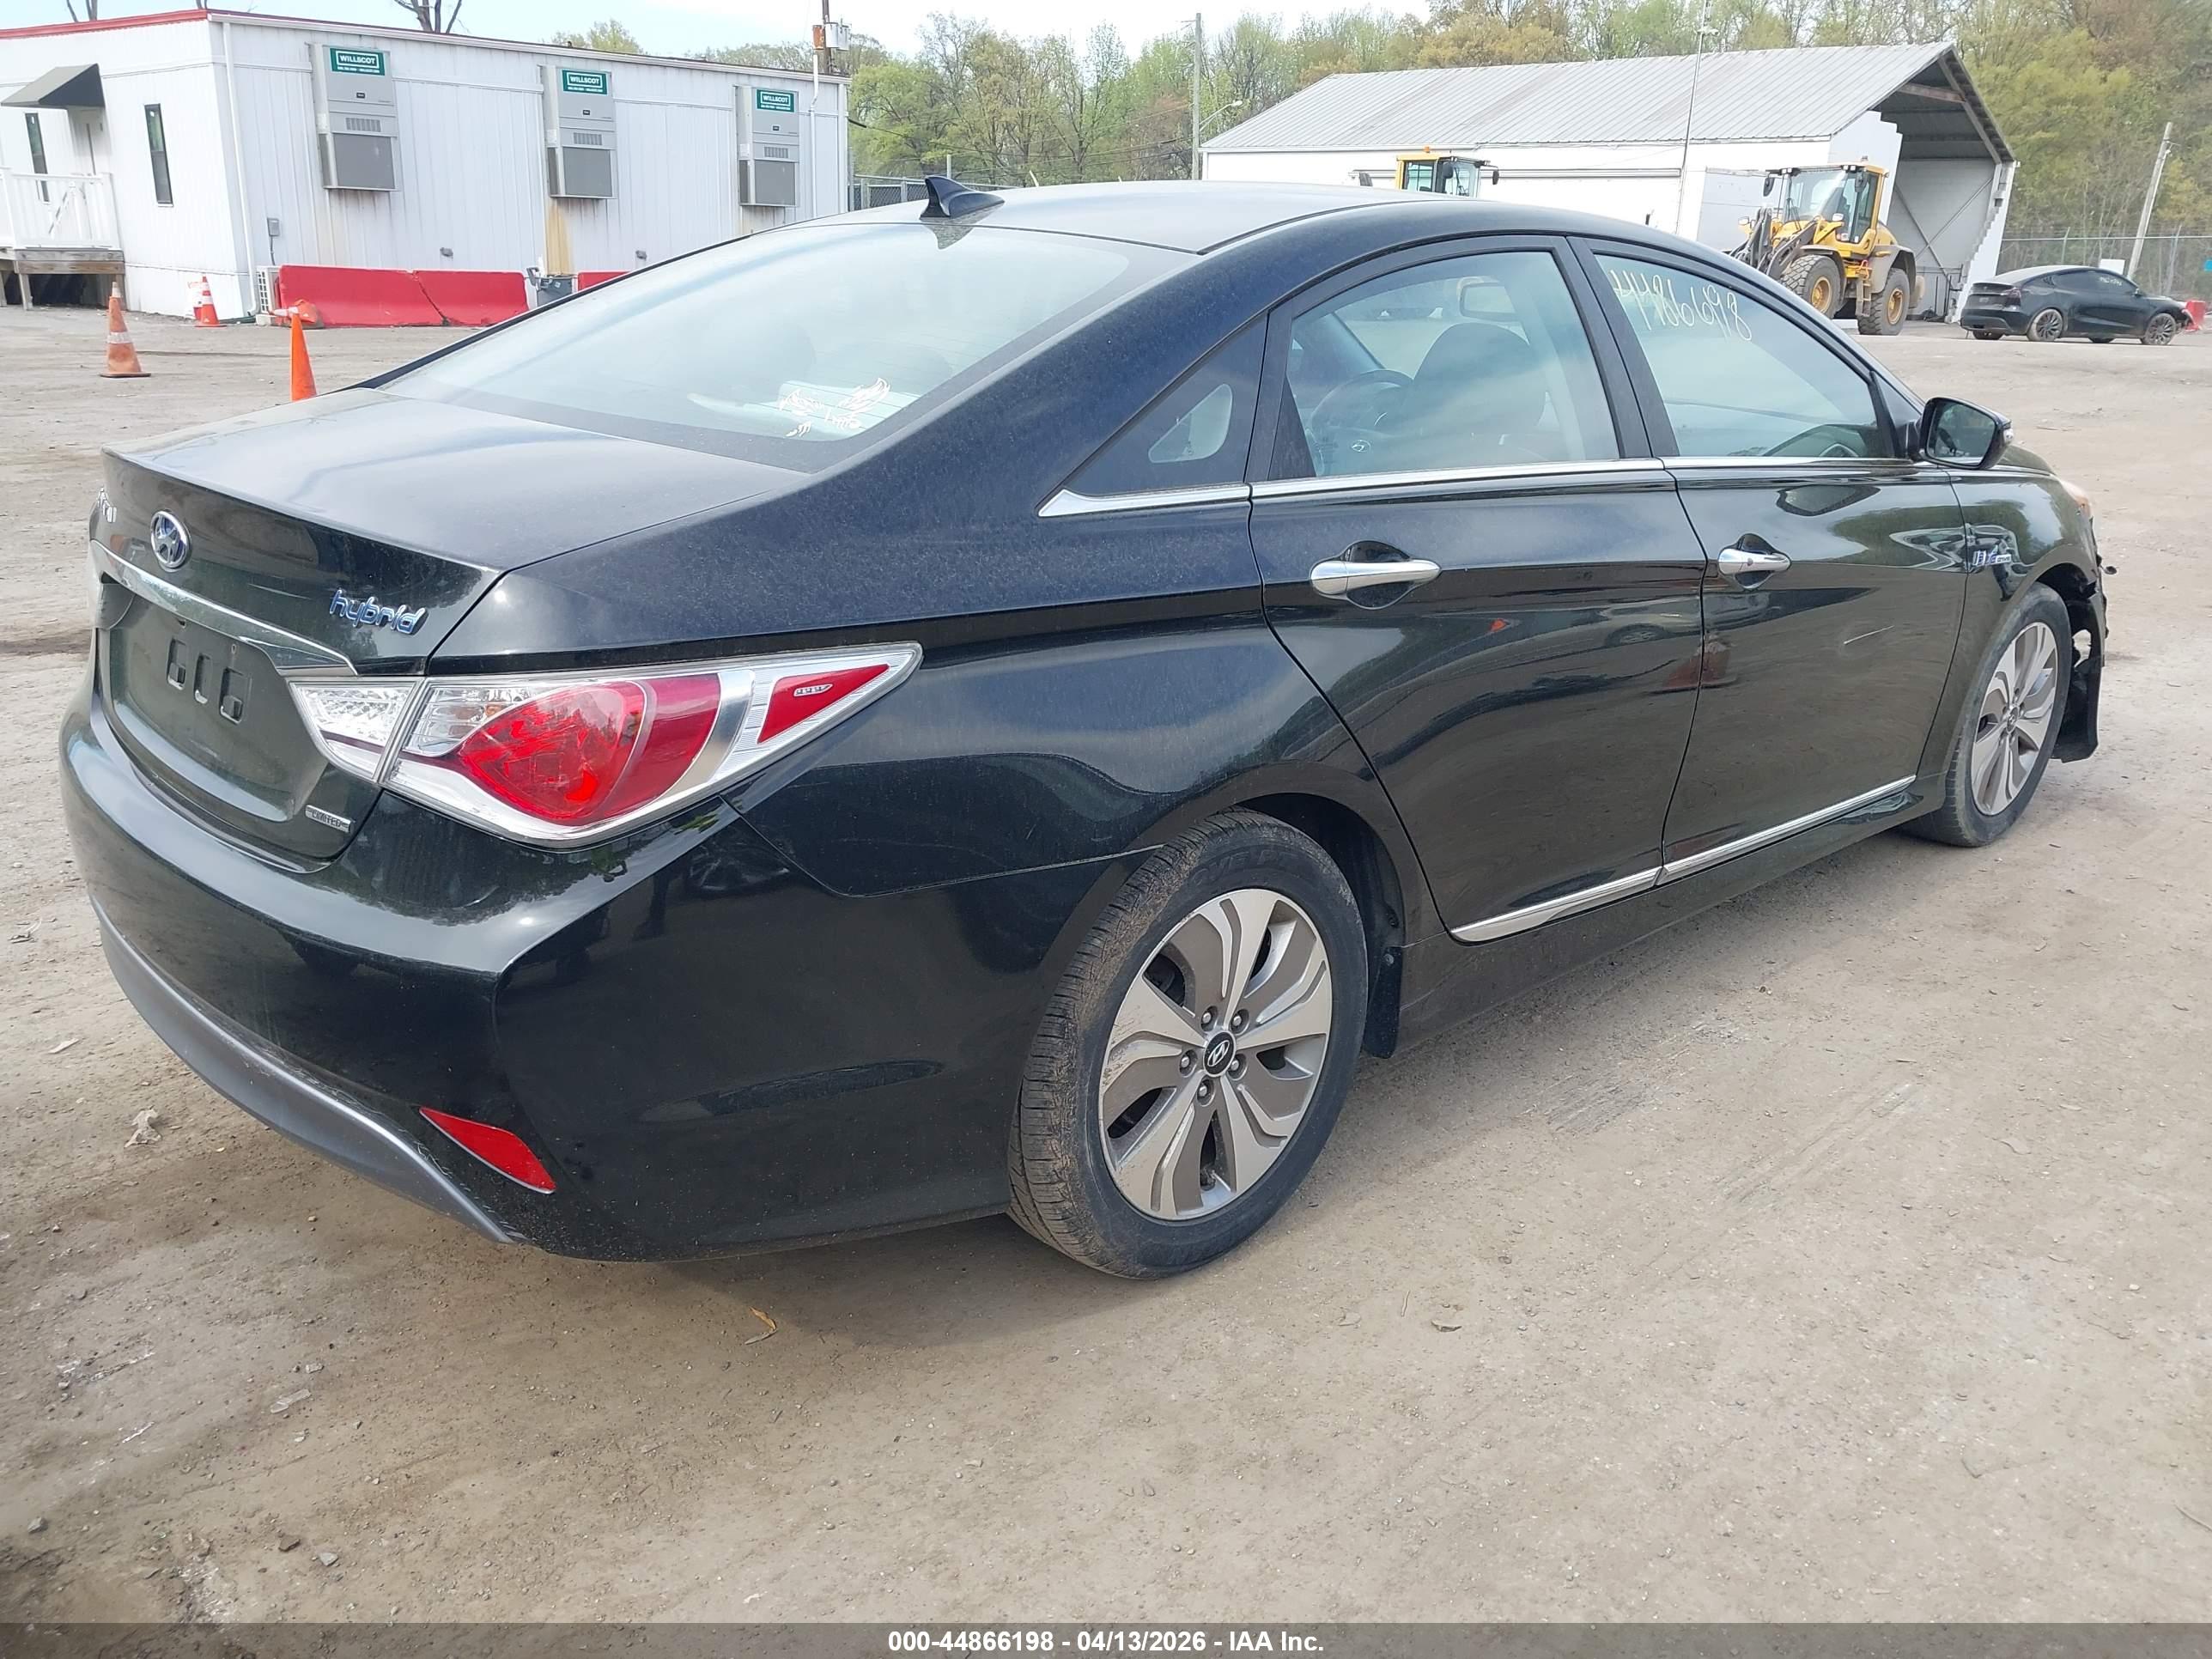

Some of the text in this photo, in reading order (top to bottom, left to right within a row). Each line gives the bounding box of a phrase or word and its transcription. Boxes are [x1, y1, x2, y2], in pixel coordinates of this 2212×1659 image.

[339, 54, 376, 64] WILLSCOT
[569, 76, 600, 84] WILLSCOT
[763, 94, 788, 103] WILLSCOT
[329, 589, 427, 634] hybrid
[312, 809, 342, 828] LIMITED
